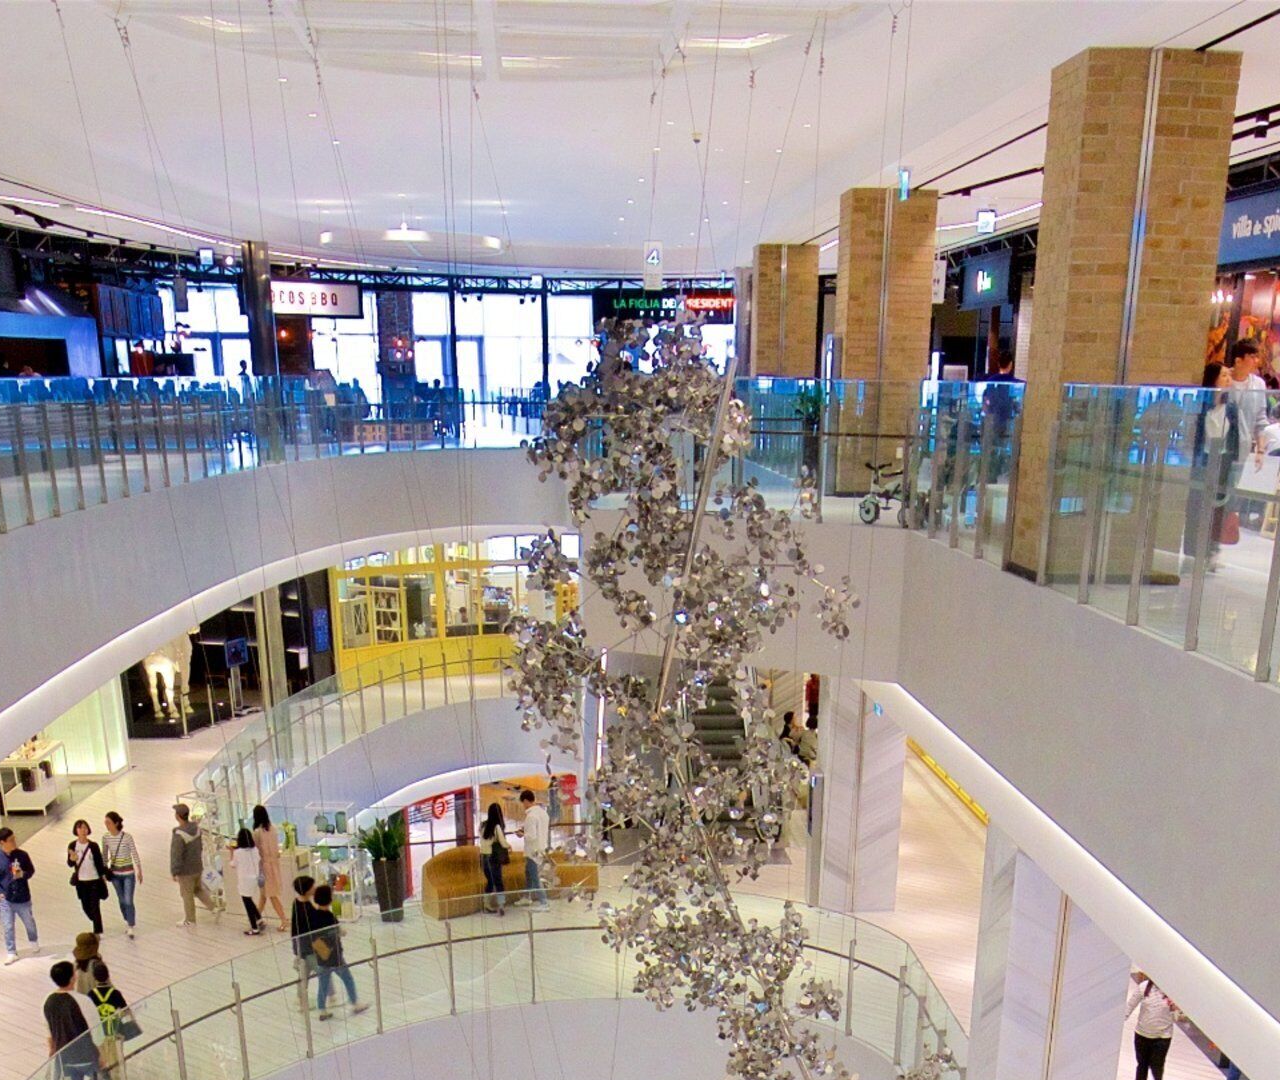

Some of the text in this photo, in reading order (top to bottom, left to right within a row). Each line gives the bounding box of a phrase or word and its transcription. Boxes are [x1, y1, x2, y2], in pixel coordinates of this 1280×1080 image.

[1232, 214, 1253, 240] villa
[646, 248, 661, 267] 4
[311, 292, 338, 306] BBQ
[613, 299, 626, 309] LA
[628, 299, 660, 309] FIGLIA
